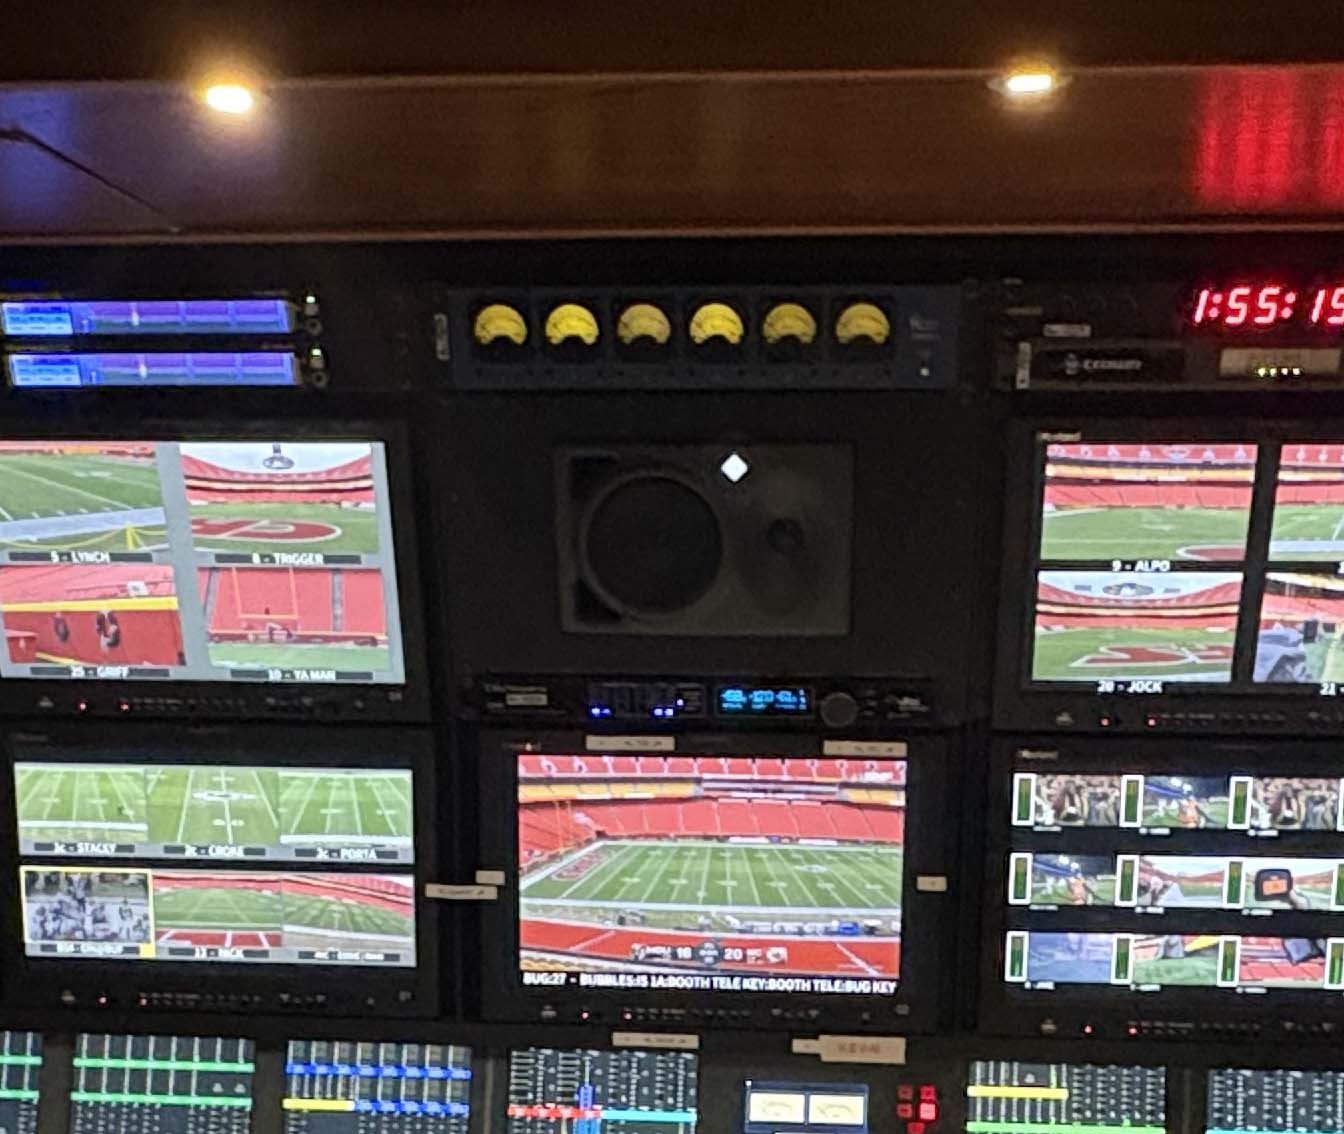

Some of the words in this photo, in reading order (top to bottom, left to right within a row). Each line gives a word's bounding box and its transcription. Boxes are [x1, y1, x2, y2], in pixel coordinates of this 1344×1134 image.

[70, 550, 112, 564] LYNCH
[273, 552, 325, 566] TRIGGER
[1134, 560, 1172, 573] ALPO
[1127, 680, 1163, 695] JOCK
